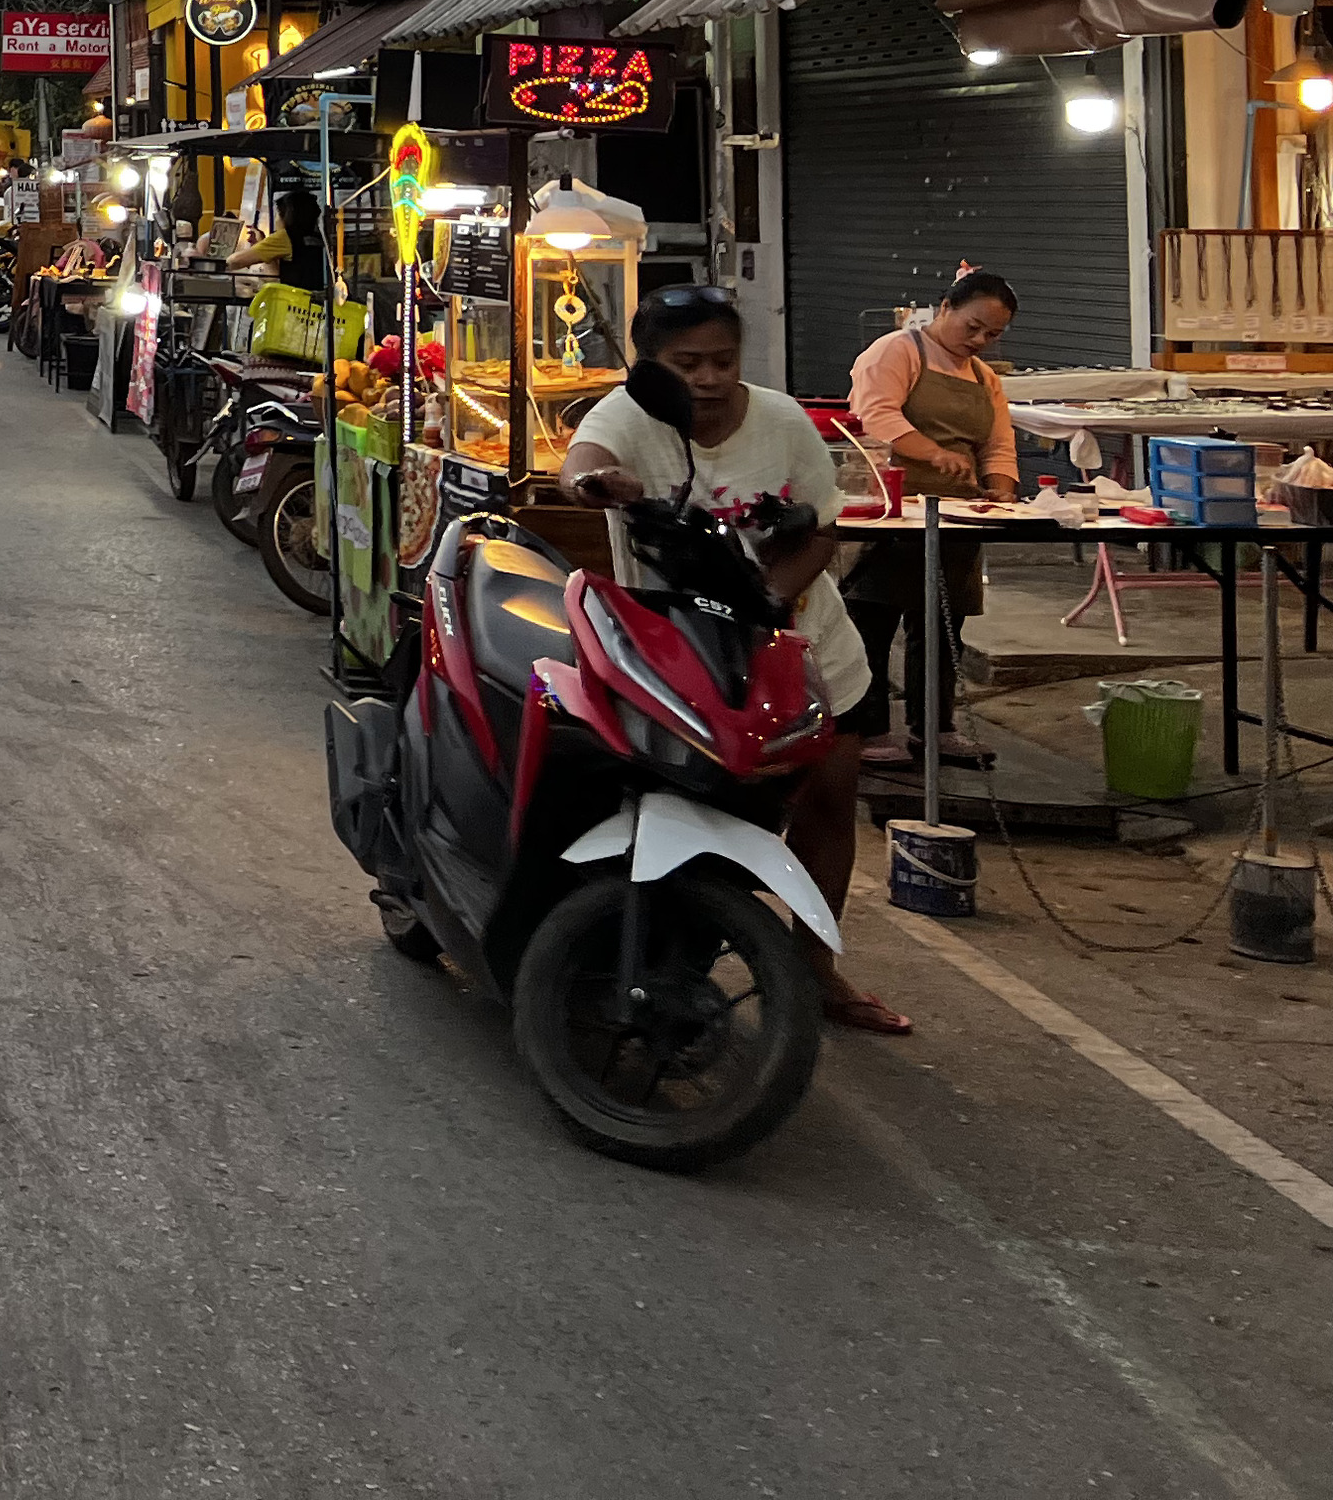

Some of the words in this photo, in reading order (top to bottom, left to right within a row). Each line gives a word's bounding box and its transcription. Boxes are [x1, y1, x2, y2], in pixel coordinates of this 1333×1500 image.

[12, 17, 50, 36] aYa
[55, 19, 110, 37] servi
[7, 38, 40, 52] Rent
[48, 43, 56, 52] a
[65, 39, 111, 53] Motor
[508, 41, 654, 83] PIZZA
